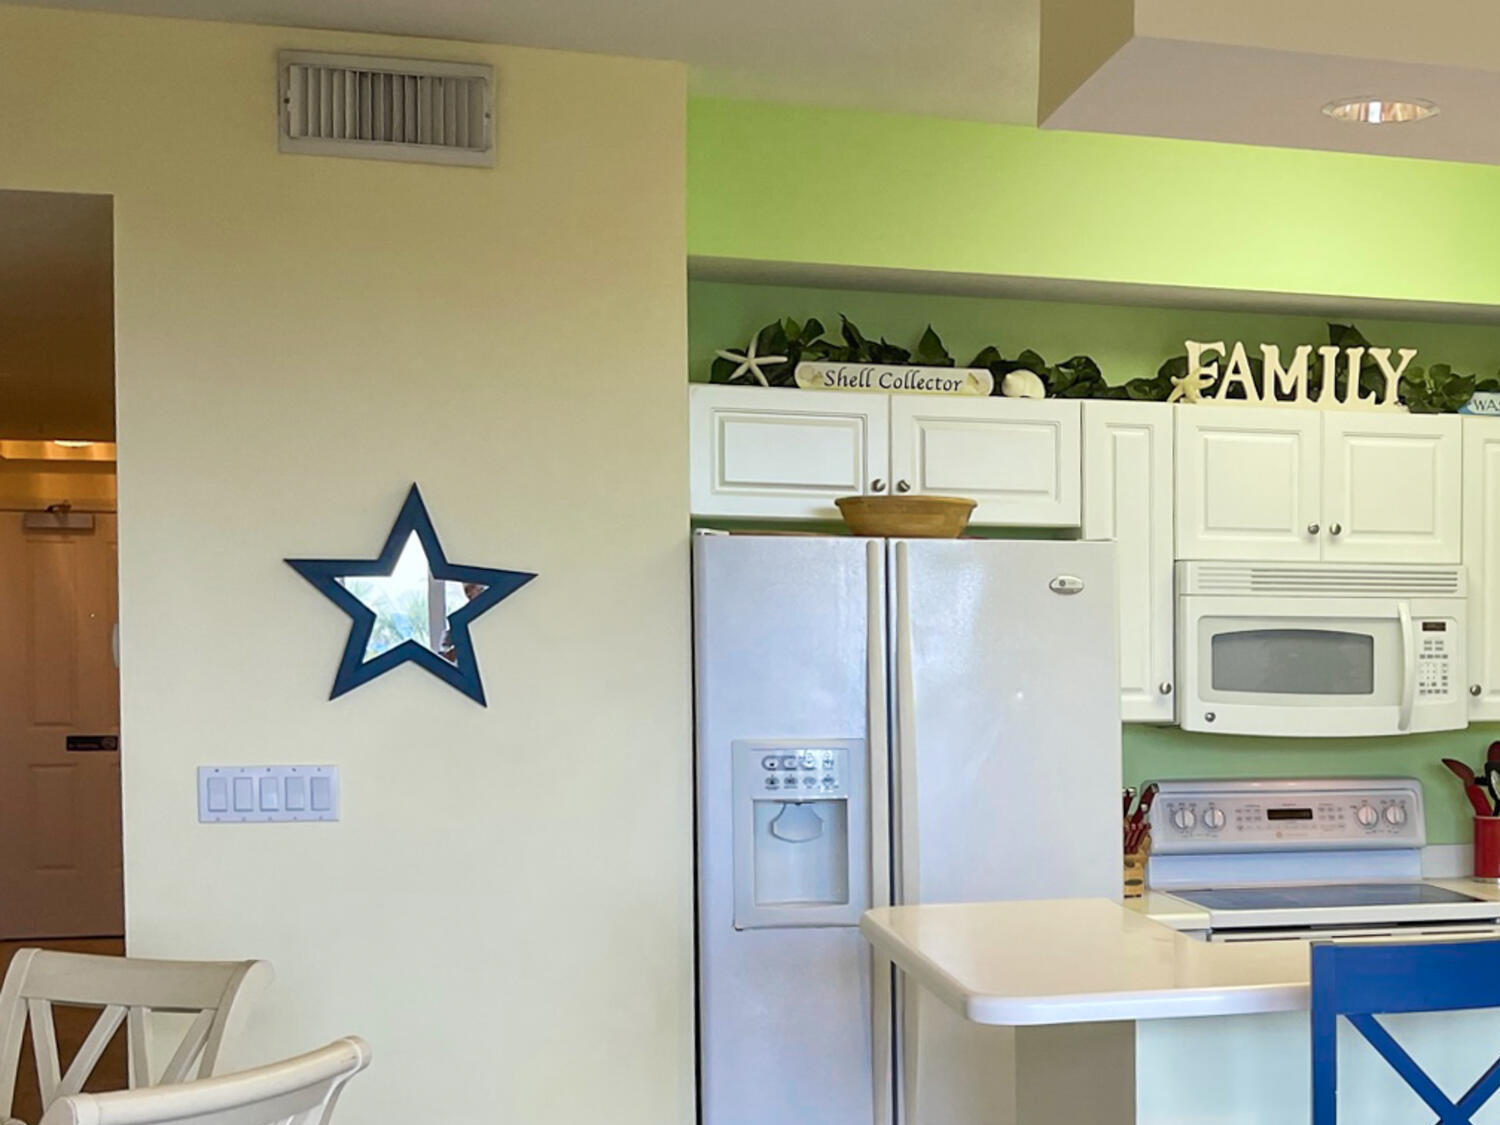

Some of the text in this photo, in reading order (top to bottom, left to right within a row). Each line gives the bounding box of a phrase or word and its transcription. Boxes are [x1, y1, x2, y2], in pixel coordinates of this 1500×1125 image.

[823, 366, 963, 392] Shell Collector
[1184, 340, 1418, 404] FAMILY
